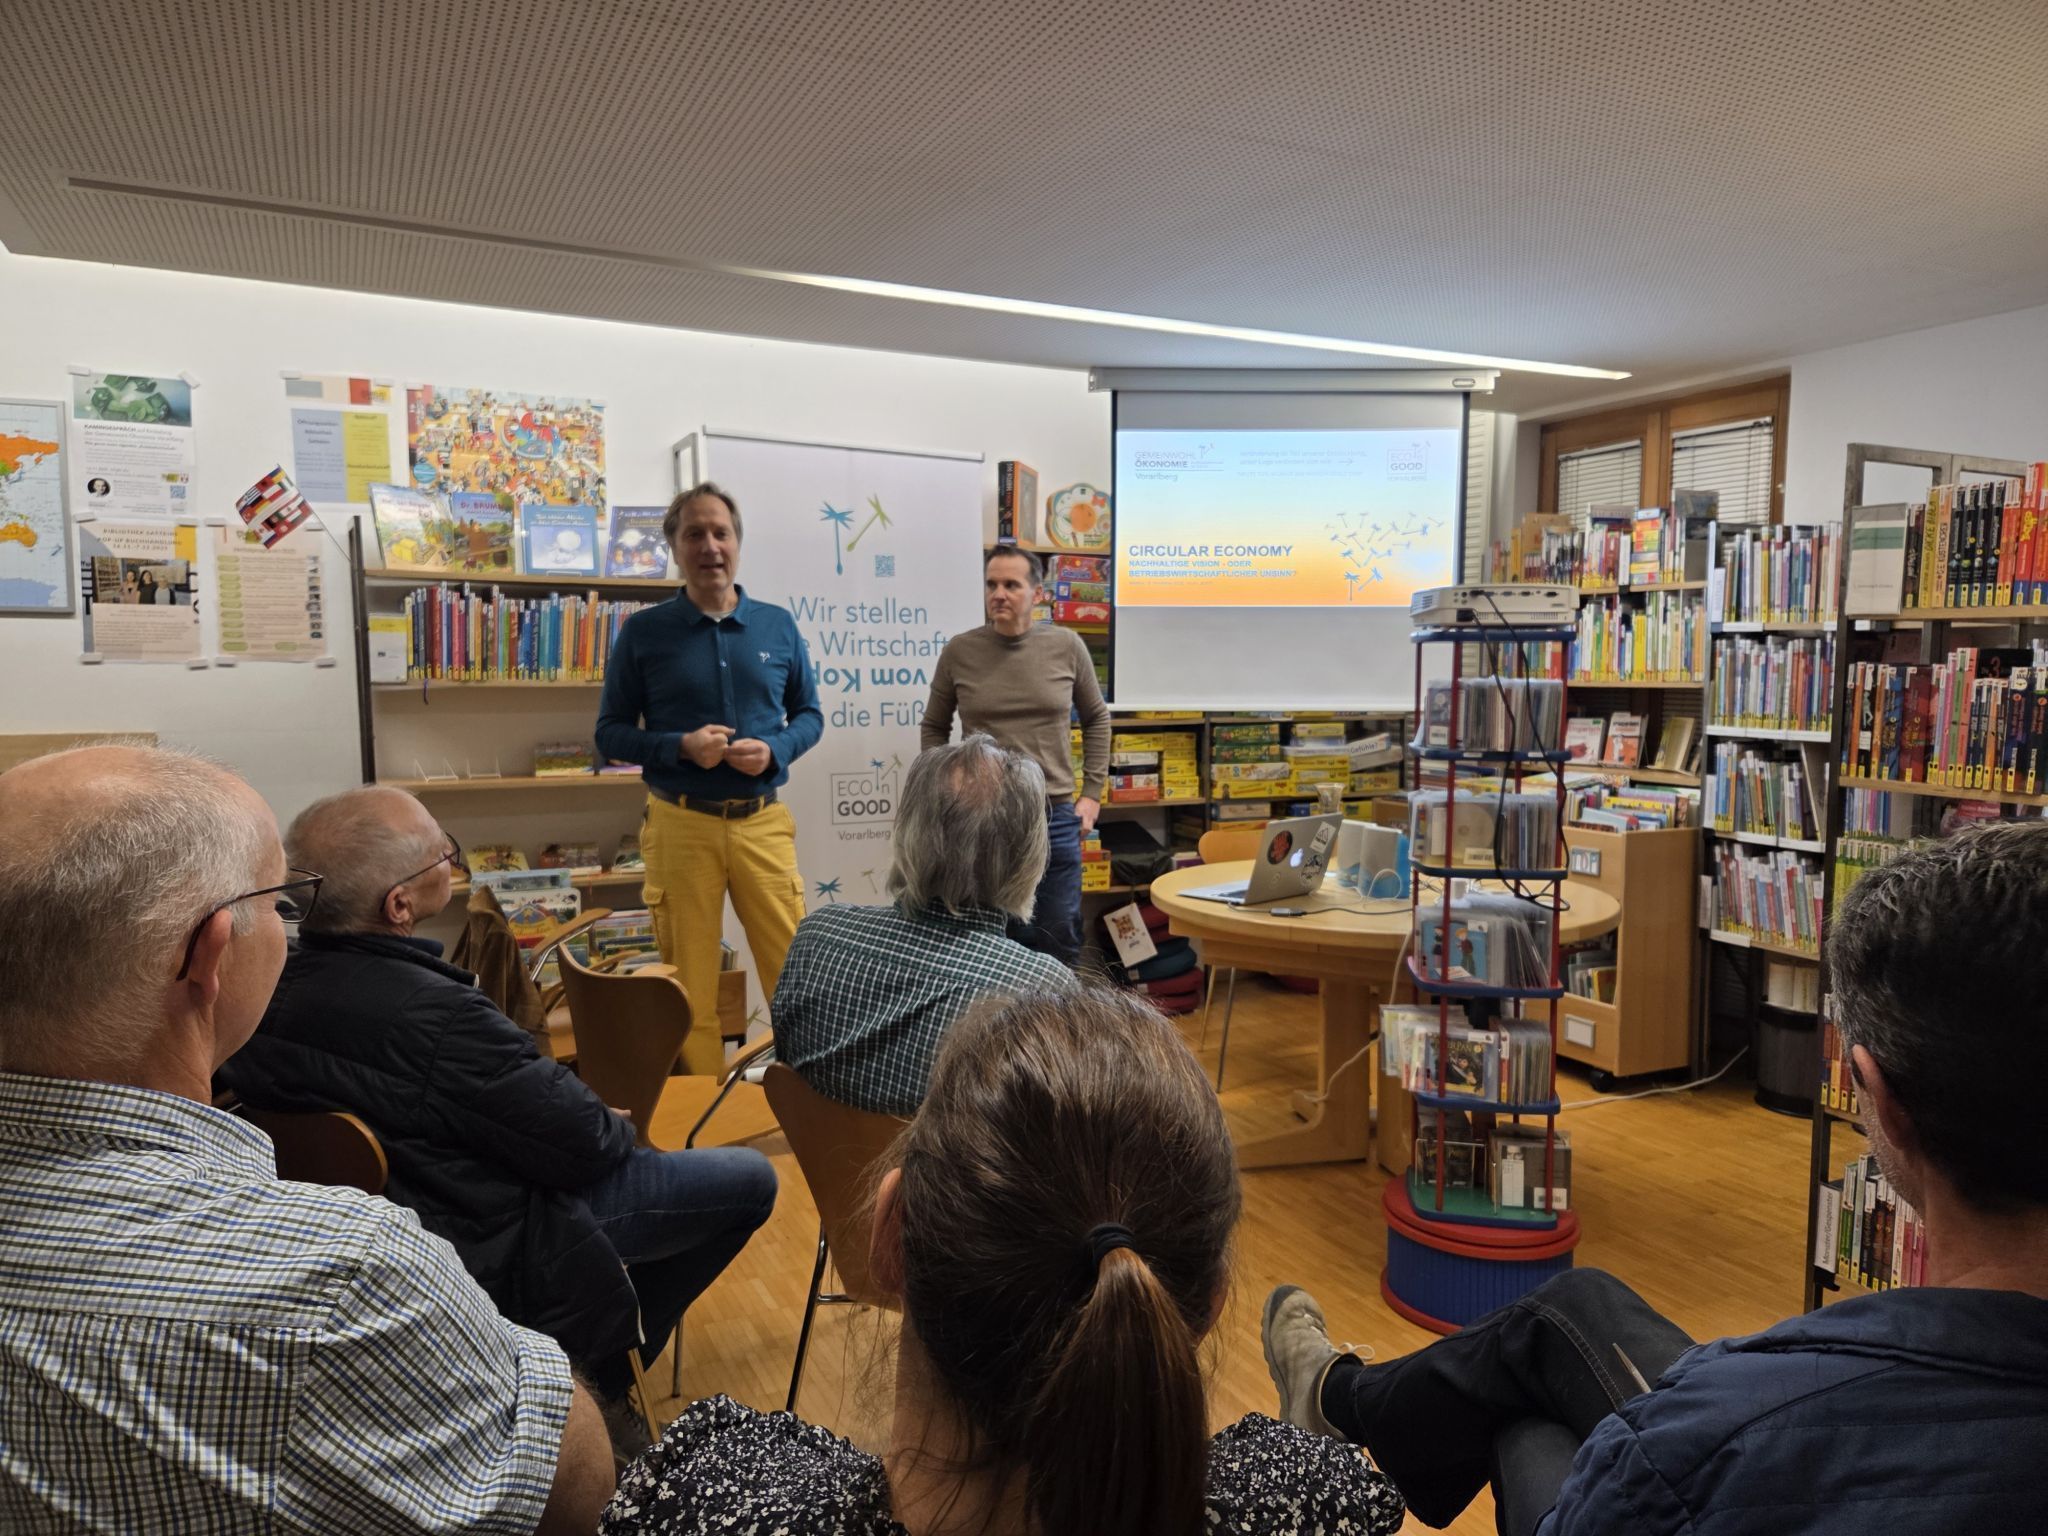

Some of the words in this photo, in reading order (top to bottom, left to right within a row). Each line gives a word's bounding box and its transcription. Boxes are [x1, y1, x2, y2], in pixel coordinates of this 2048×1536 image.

[1134, 459, 1189, 468] ÖKONOMIE
[1391, 462, 1423, 471] GOOD
[1135, 472, 1178, 482] Vorarlberg
[1129, 545, 1210, 557] CIRCULAR
[1214, 545, 1293, 557] ECONOMY
[1129, 560, 1190, 568] NACHHALTIGE
[1192, 560, 1220, 568] VISION
[1227, 560, 1252, 568] ODER
[1129, 570, 1258, 578] BETRIEBSWIRTSCHAFTLICHER
[1261, 569, 1297, 578] UNSINN?
[789, 596, 837, 622] Wir
[846, 597, 928, 624] stellen
[819, 631, 949, 656] Wirtschaft
[815, 661, 861, 693] Kop
[871, 668, 928, 685] vom
[831, 702, 870, 727] die
[880, 700, 926, 727] Füß
[838, 799, 891, 816] GOOD
[838, 828, 891, 841] Vorarlberg
